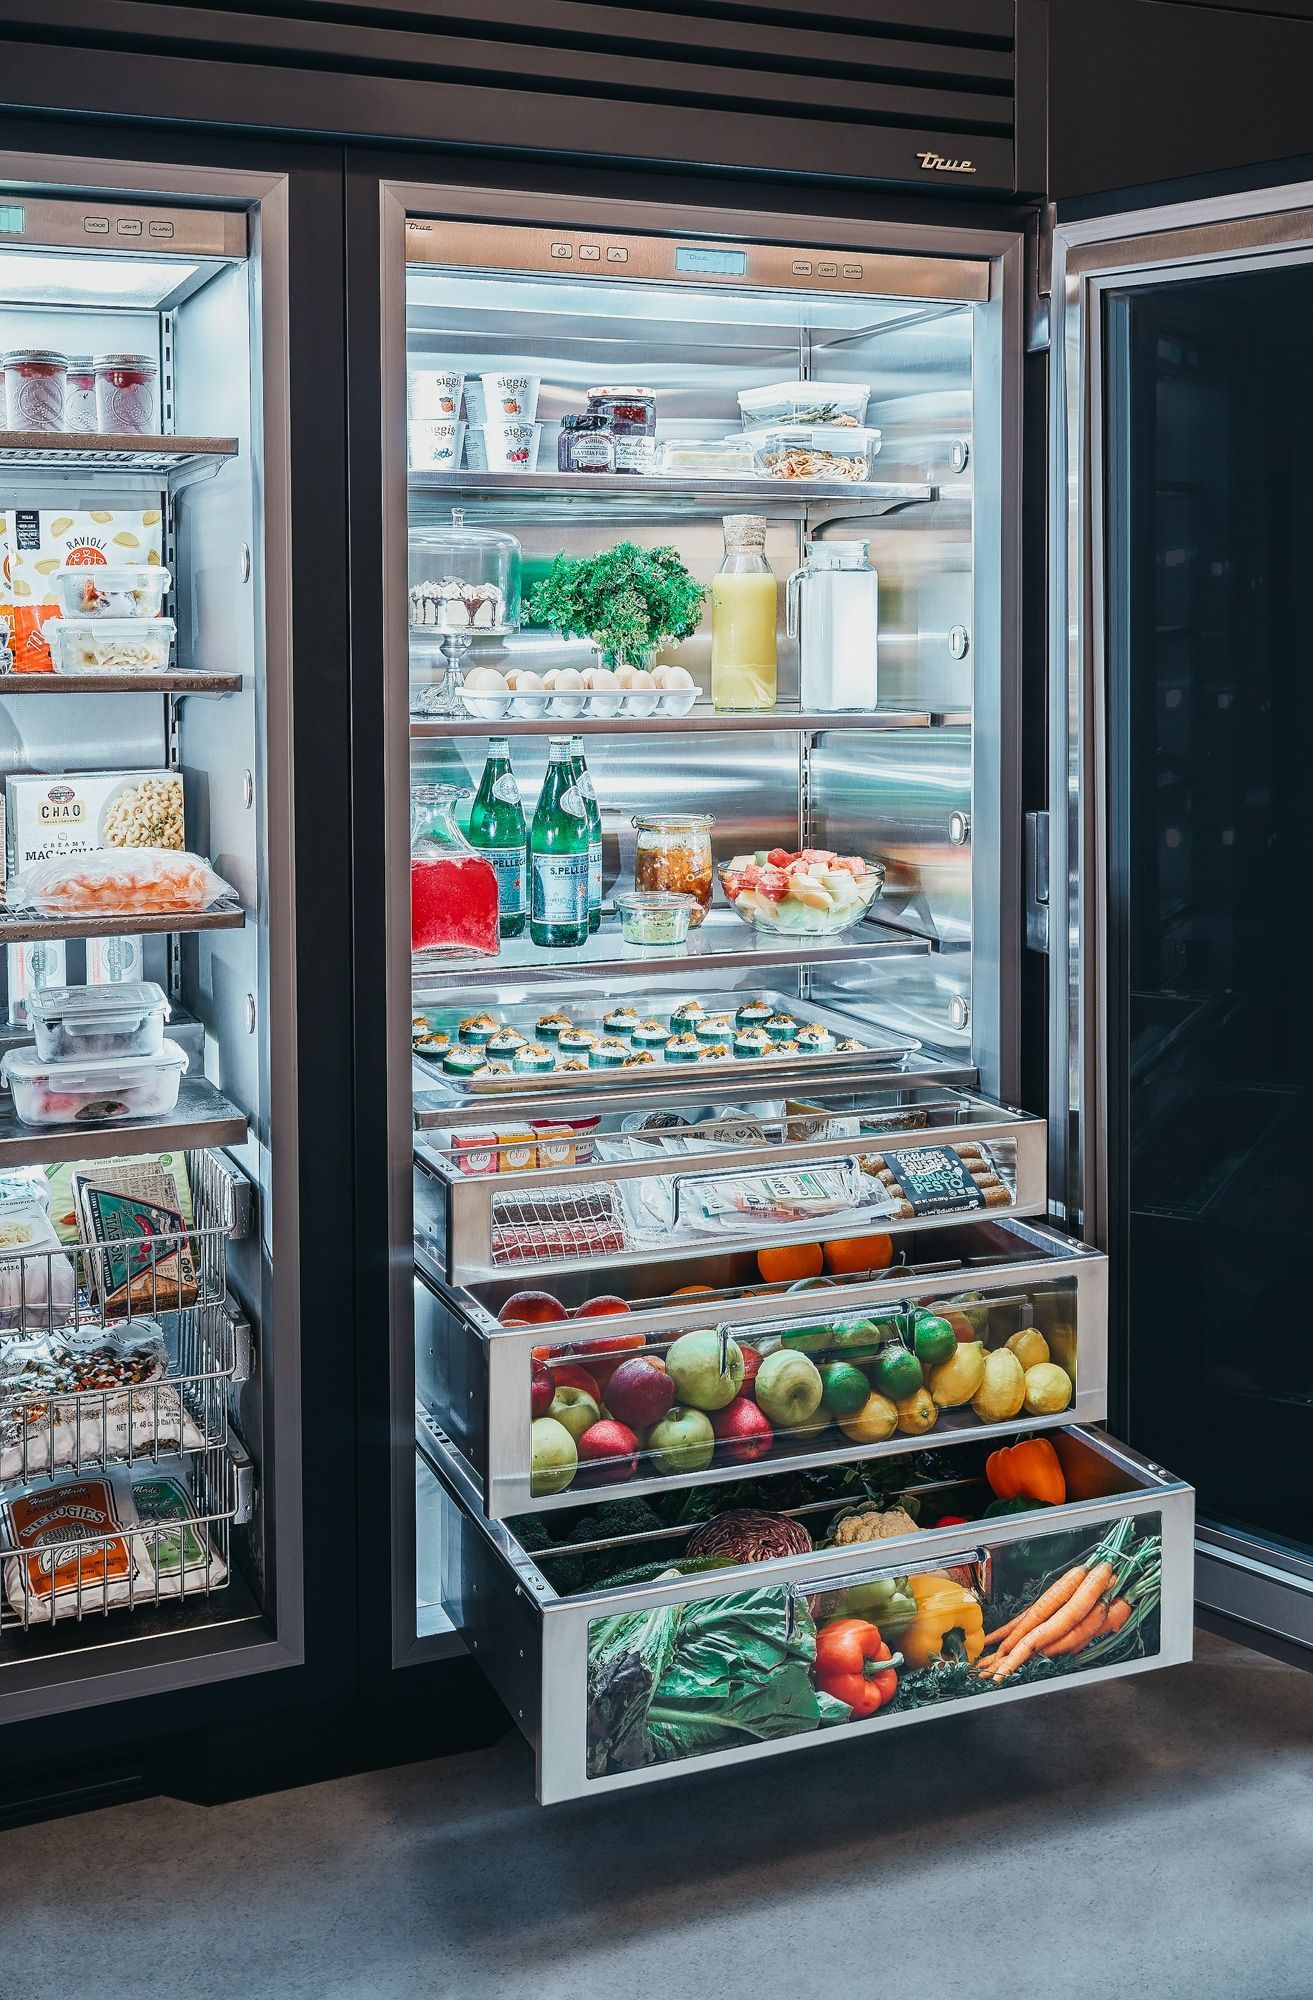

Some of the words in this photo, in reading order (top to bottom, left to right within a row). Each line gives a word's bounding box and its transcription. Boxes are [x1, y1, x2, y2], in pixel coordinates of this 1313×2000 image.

[917, 152, 976, 172] true
[65, 536, 109, 550] RAVIOLI
[41, 804, 81, 819] CHAO
[43, 841, 86, 849] CREAMY
[470, 1152, 488, 1163] Clio
[509, 1149, 527, 1160] Clio
[908, 1170, 958, 1184] SPINACH
[914, 1179, 964, 1194] PESTO
[116, 1423, 127, 1431] NET
[132, 1485, 158, 1494] Made
[20, 1505, 107, 1537] PIEROGIES
